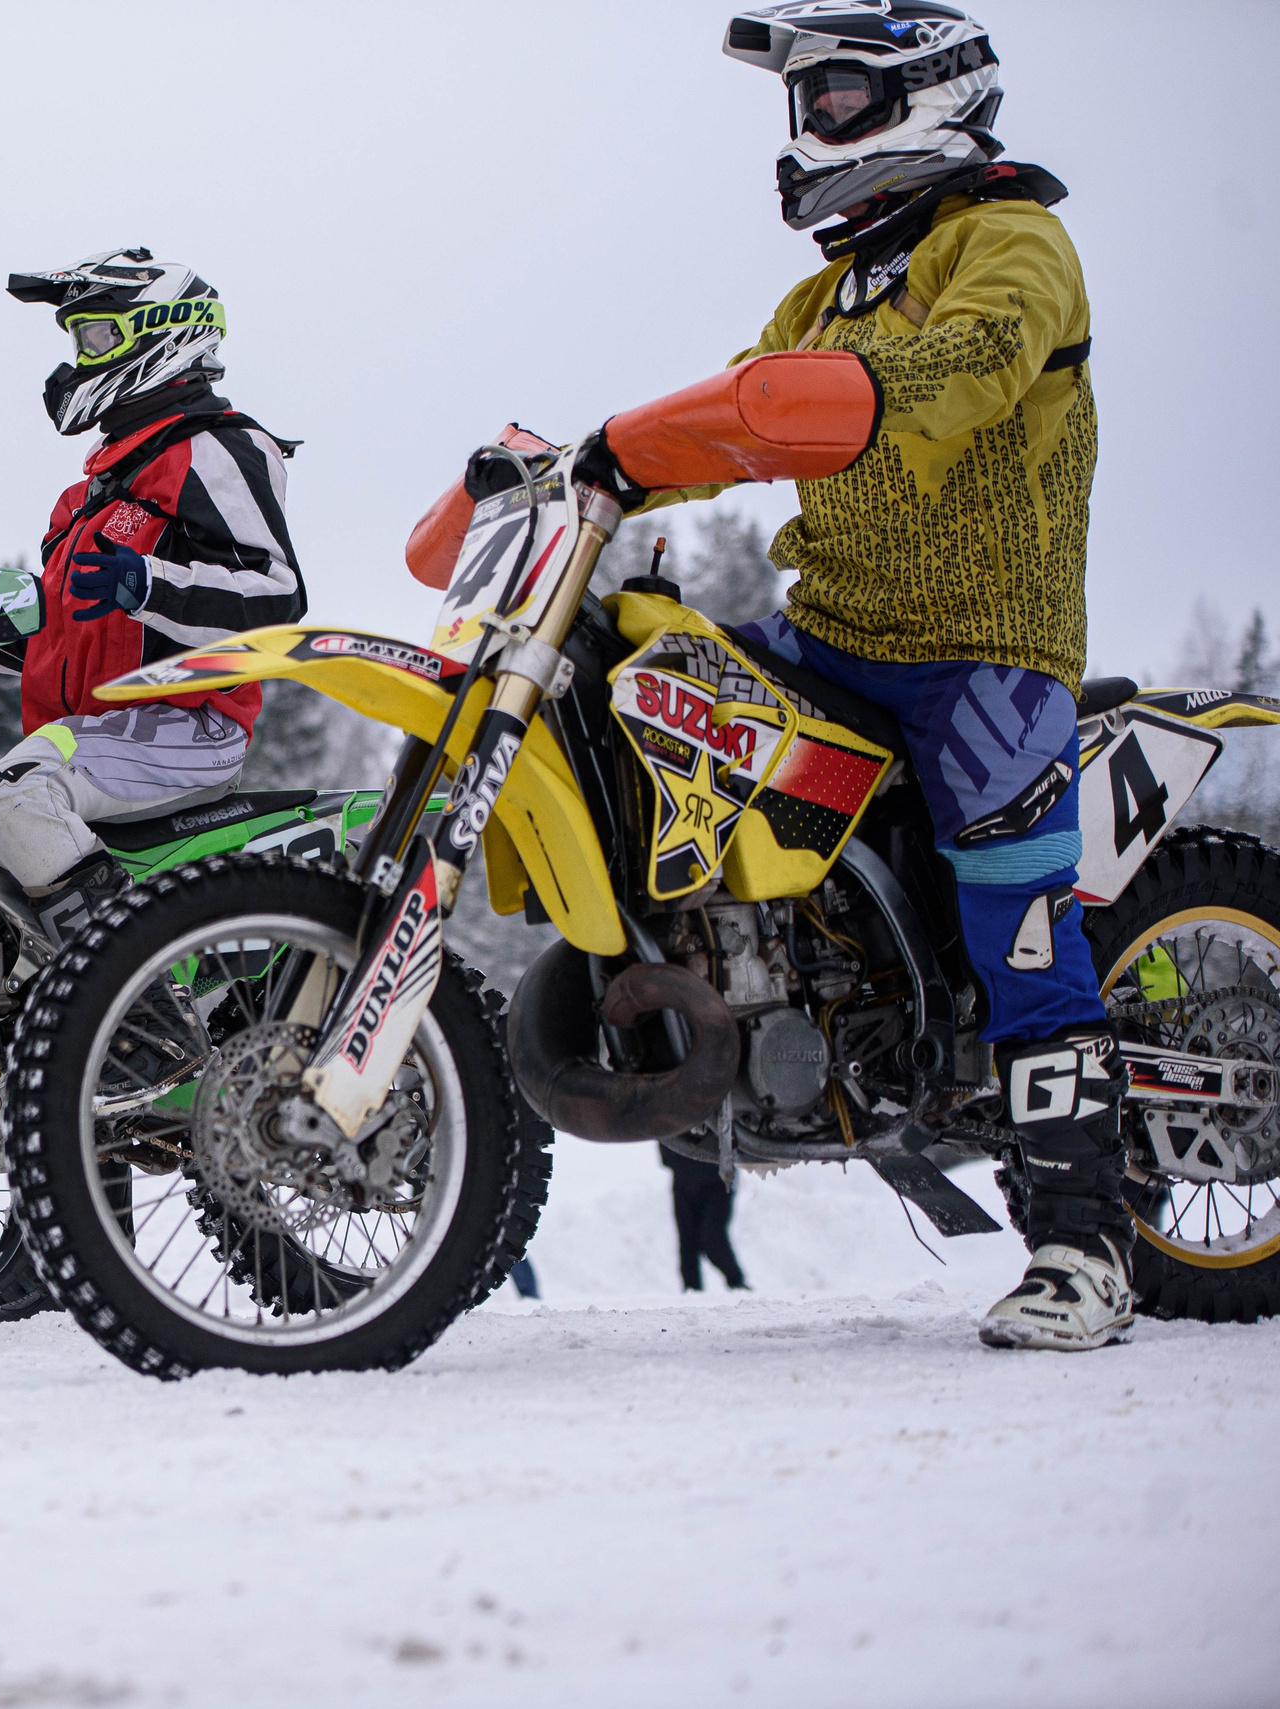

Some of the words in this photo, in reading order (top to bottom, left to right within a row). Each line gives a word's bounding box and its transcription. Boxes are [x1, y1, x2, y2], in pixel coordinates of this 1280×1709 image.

[128, 302, 214, 335] 100%
[898, 383, 945, 394] ACERBIS
[443, 515, 531, 612] 4
[353, 640, 443, 674] MAXIMA
[635, 673, 756, 771] SUZUKI
[172, 801, 253, 832] Kawasaki
[1108, 729, 1169, 859] 4
[345, 889, 425, 1069] DUNLOP
